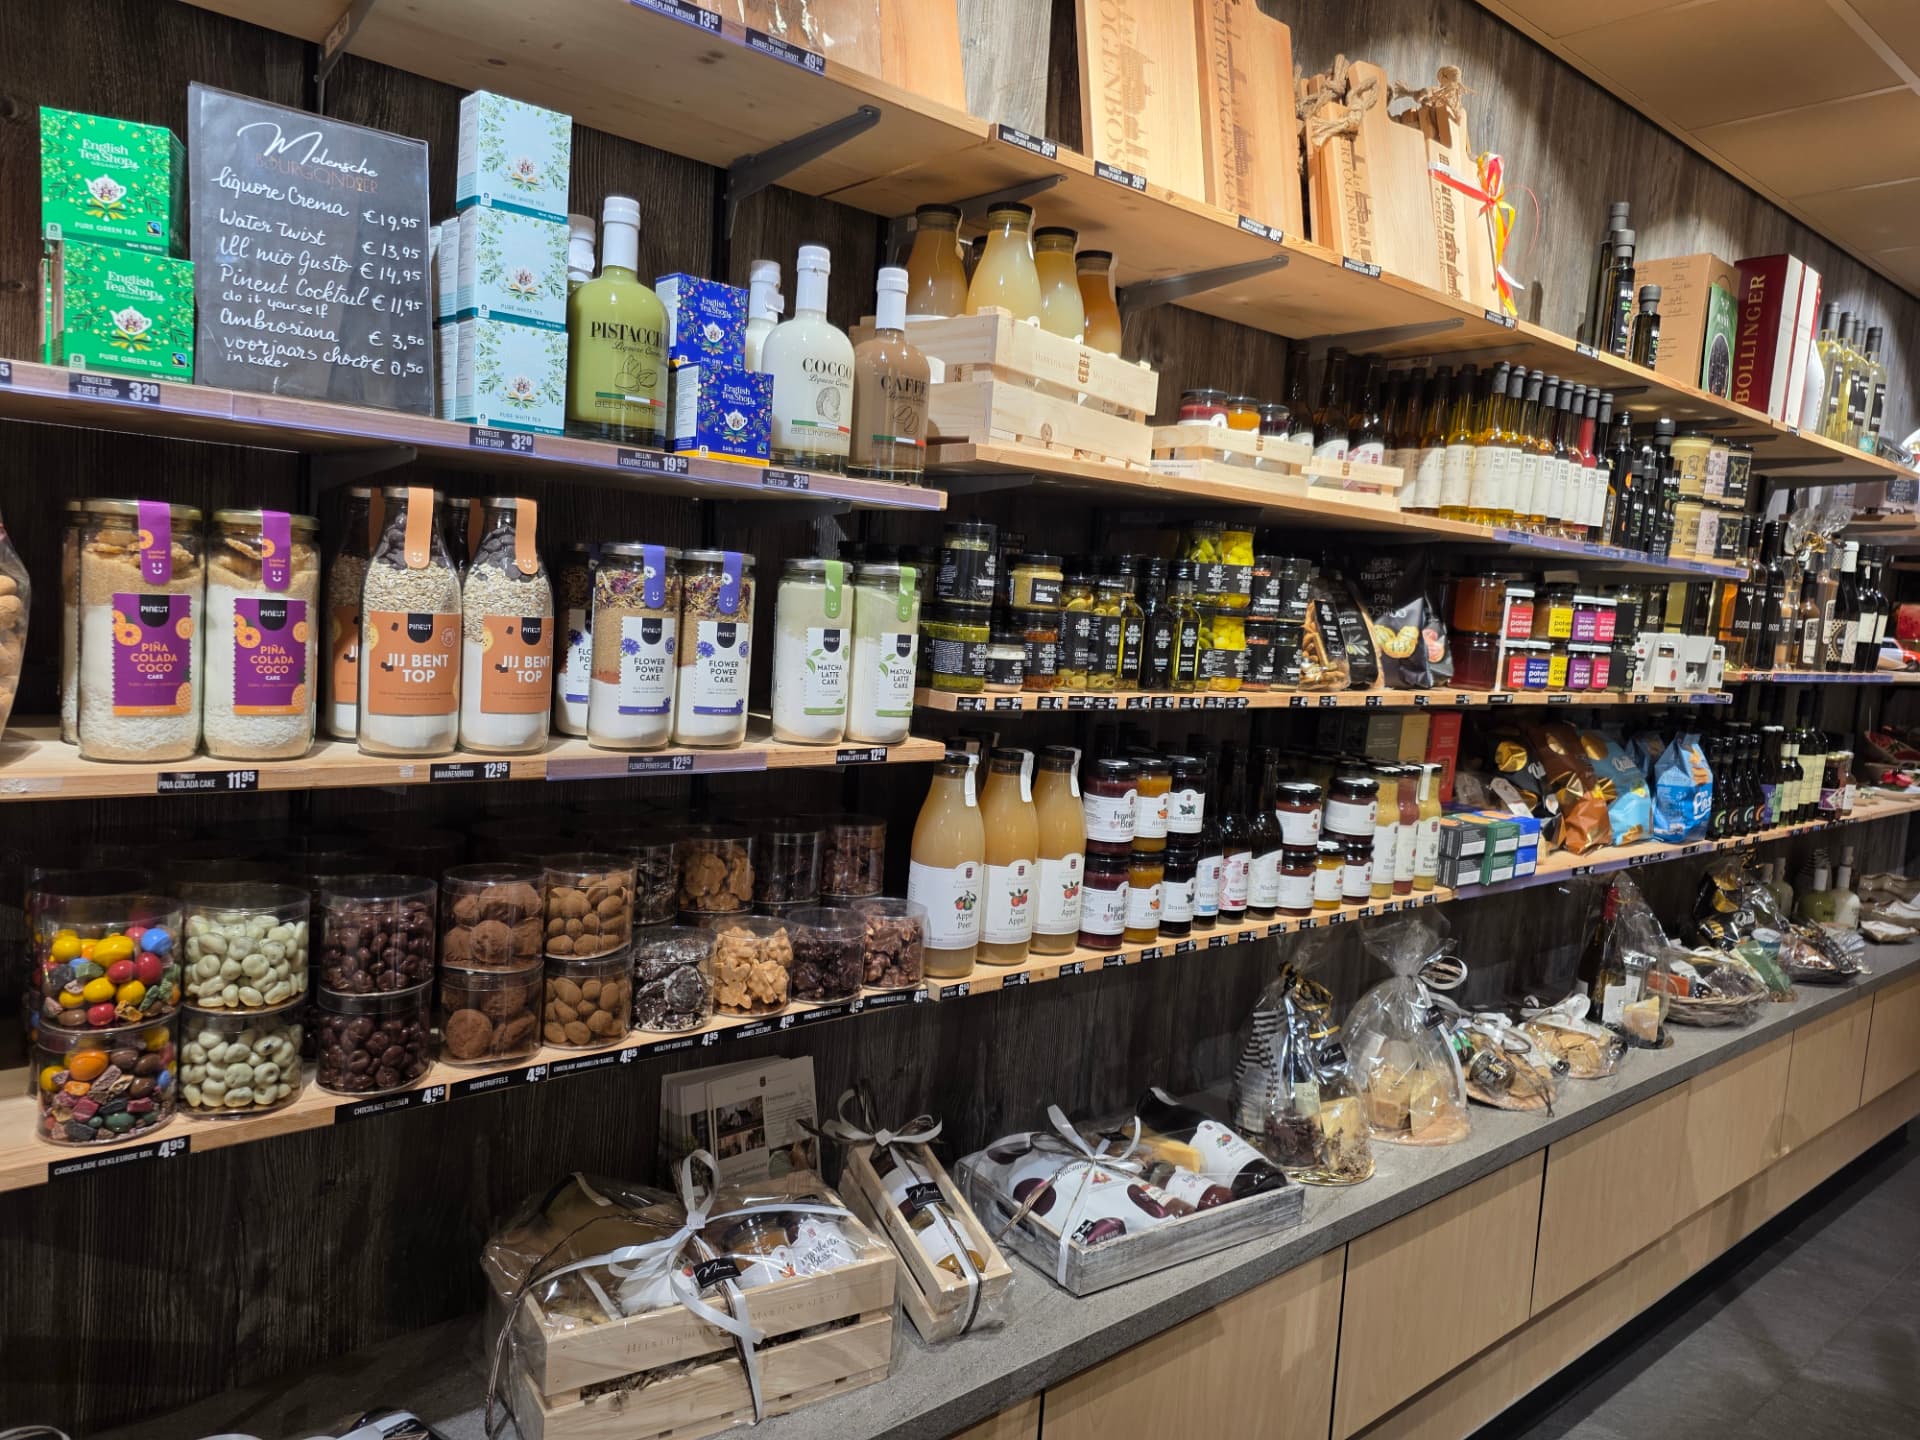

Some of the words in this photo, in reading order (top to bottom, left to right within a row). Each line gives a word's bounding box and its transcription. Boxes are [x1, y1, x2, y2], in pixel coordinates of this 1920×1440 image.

[82, 138, 129, 156] English
[78, 148, 101, 161] Tea
[100, 151, 133, 169] Shop
[219, 208, 272, 233] Water
[74, 222, 95, 231] PURE
[96, 224, 122, 235] GREEN
[124, 228, 138, 236] TEA
[298, 250, 353, 275] Gusto
[107, 270, 154, 287] English
[220, 263, 288, 295] Pineut
[296, 279, 370, 307] Cocktail
[104, 280, 126, 292] Tea
[125, 283, 161, 302] Shop
[222, 290, 242, 302] do
[248, 294, 263, 306] it
[701, 296, 727, 310] English
[1735, 274, 1766, 403] BOLLINGER
[224, 336, 318, 362] voorjaars
[323, 347, 373, 370] choco
[226, 351, 243, 363] in
[99, 353, 118, 362] PURE
[120, 355, 147, 366] GREEN
[149, 359, 163, 368] TEA
[78, 384, 97, 396] THEE
[98, 386, 119, 398] SHOP
[723, 383, 750, 396] English
[141, 641, 168, 653] PIÑA
[260, 644, 286, 655] PIÑA
[578, 648, 591, 656] FLO
[130, 653, 178, 663] COLADA
[250, 656, 294, 665] COLADA
[386, 653, 405, 668] JIJ
[411, 654, 449, 668] BENT
[501, 655, 519, 668] JIJ
[524, 655, 551, 668] BENT
[634, 657, 666, 665] FLOWER
[709, 660, 739, 668] FLOWER
[136, 663, 173, 673] COCO
[256, 665, 289, 674] COCO
[817, 664, 843, 672] MATCHA
[889, 668, 912, 676] MATCHA
[402, 670, 436, 683] TOP
[516, 671, 542, 683] TOP
[821, 678, 839, 686] CAKE
[422, 1086, 445, 1104] 4.95
[54, 1158, 97, 1176] CHOCOLADE
[158, 1138, 185, 1158] 4.95
